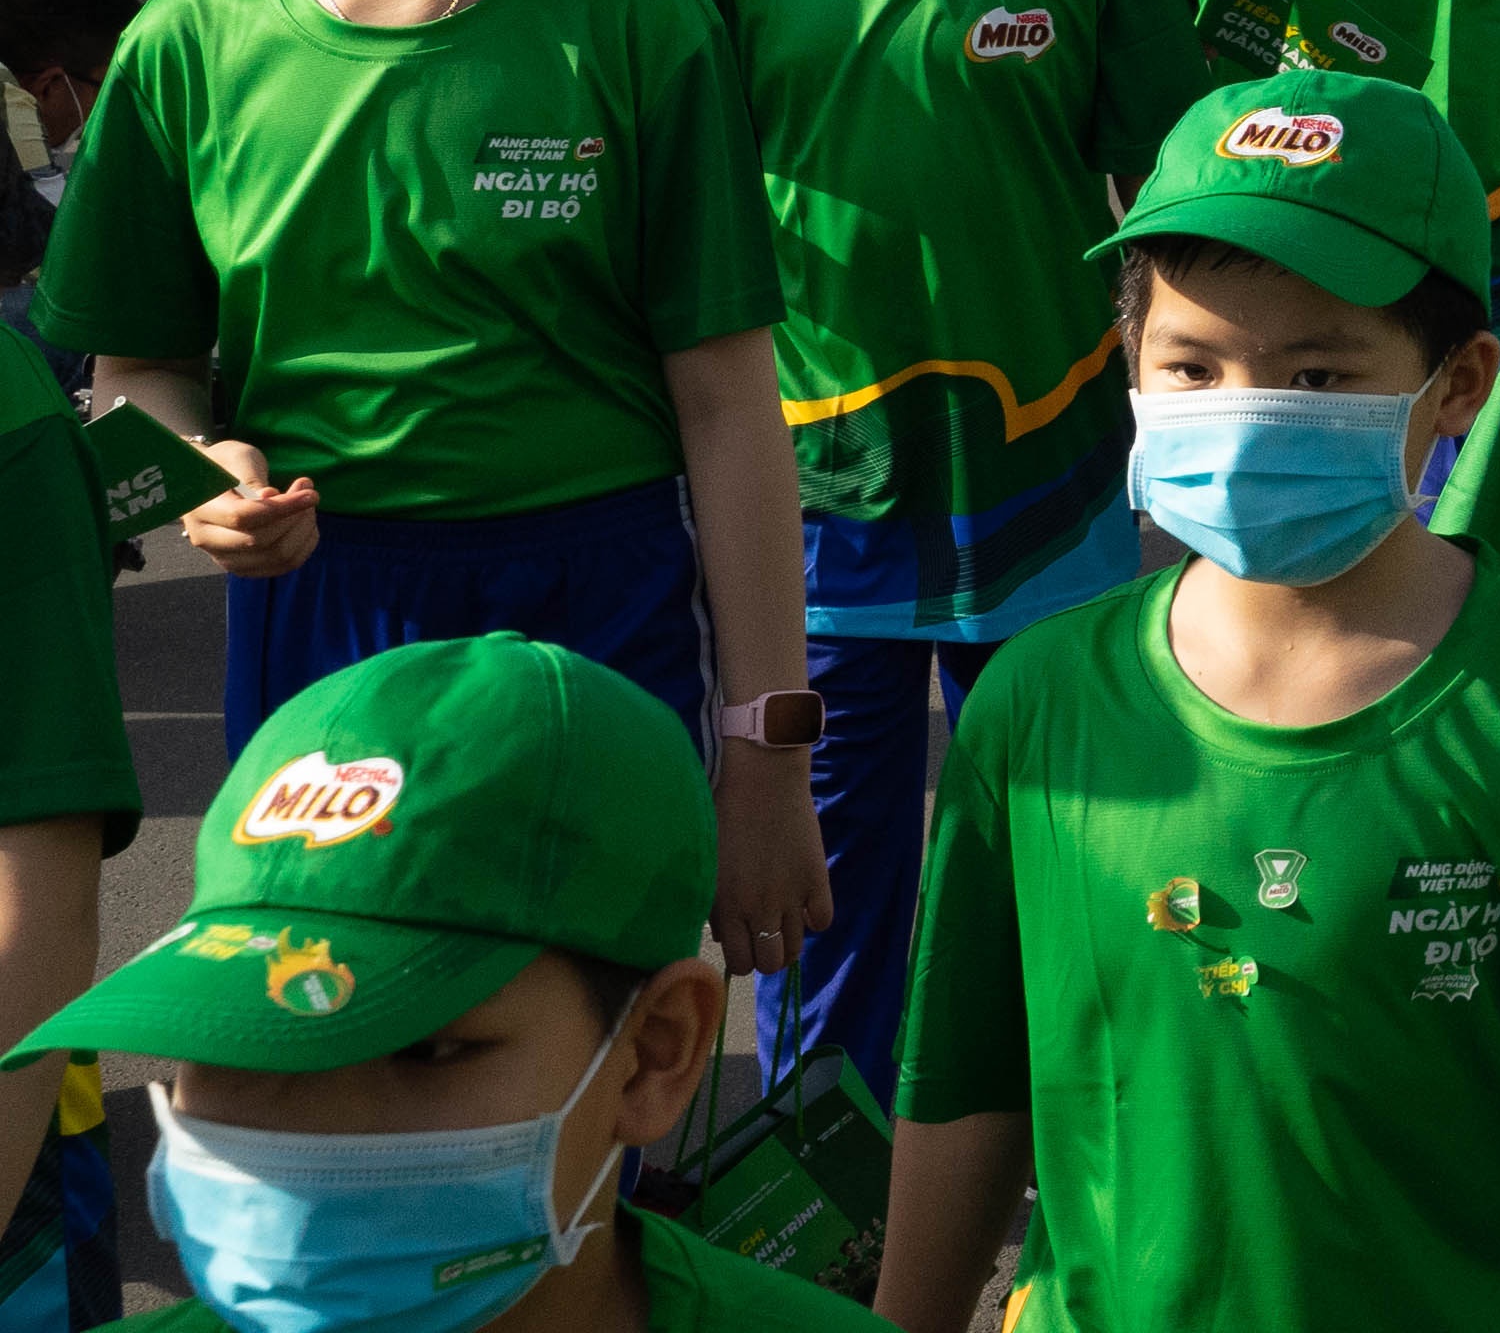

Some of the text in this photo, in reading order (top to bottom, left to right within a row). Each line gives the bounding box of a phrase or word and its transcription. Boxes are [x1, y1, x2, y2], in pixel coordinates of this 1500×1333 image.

[977, 23, 1051, 50] MILO
[1335, 23, 1381, 57] MILO
[1237, 121, 1335, 153] MILO
[473, 165, 599, 197] NGÀY HỘ
[500, 194, 581, 224] ĐI BỘ
[263, 783, 381, 822] MILO
[1389, 903, 1479, 935] NGÀY
[1424, 938, 1461, 966] ĐI
